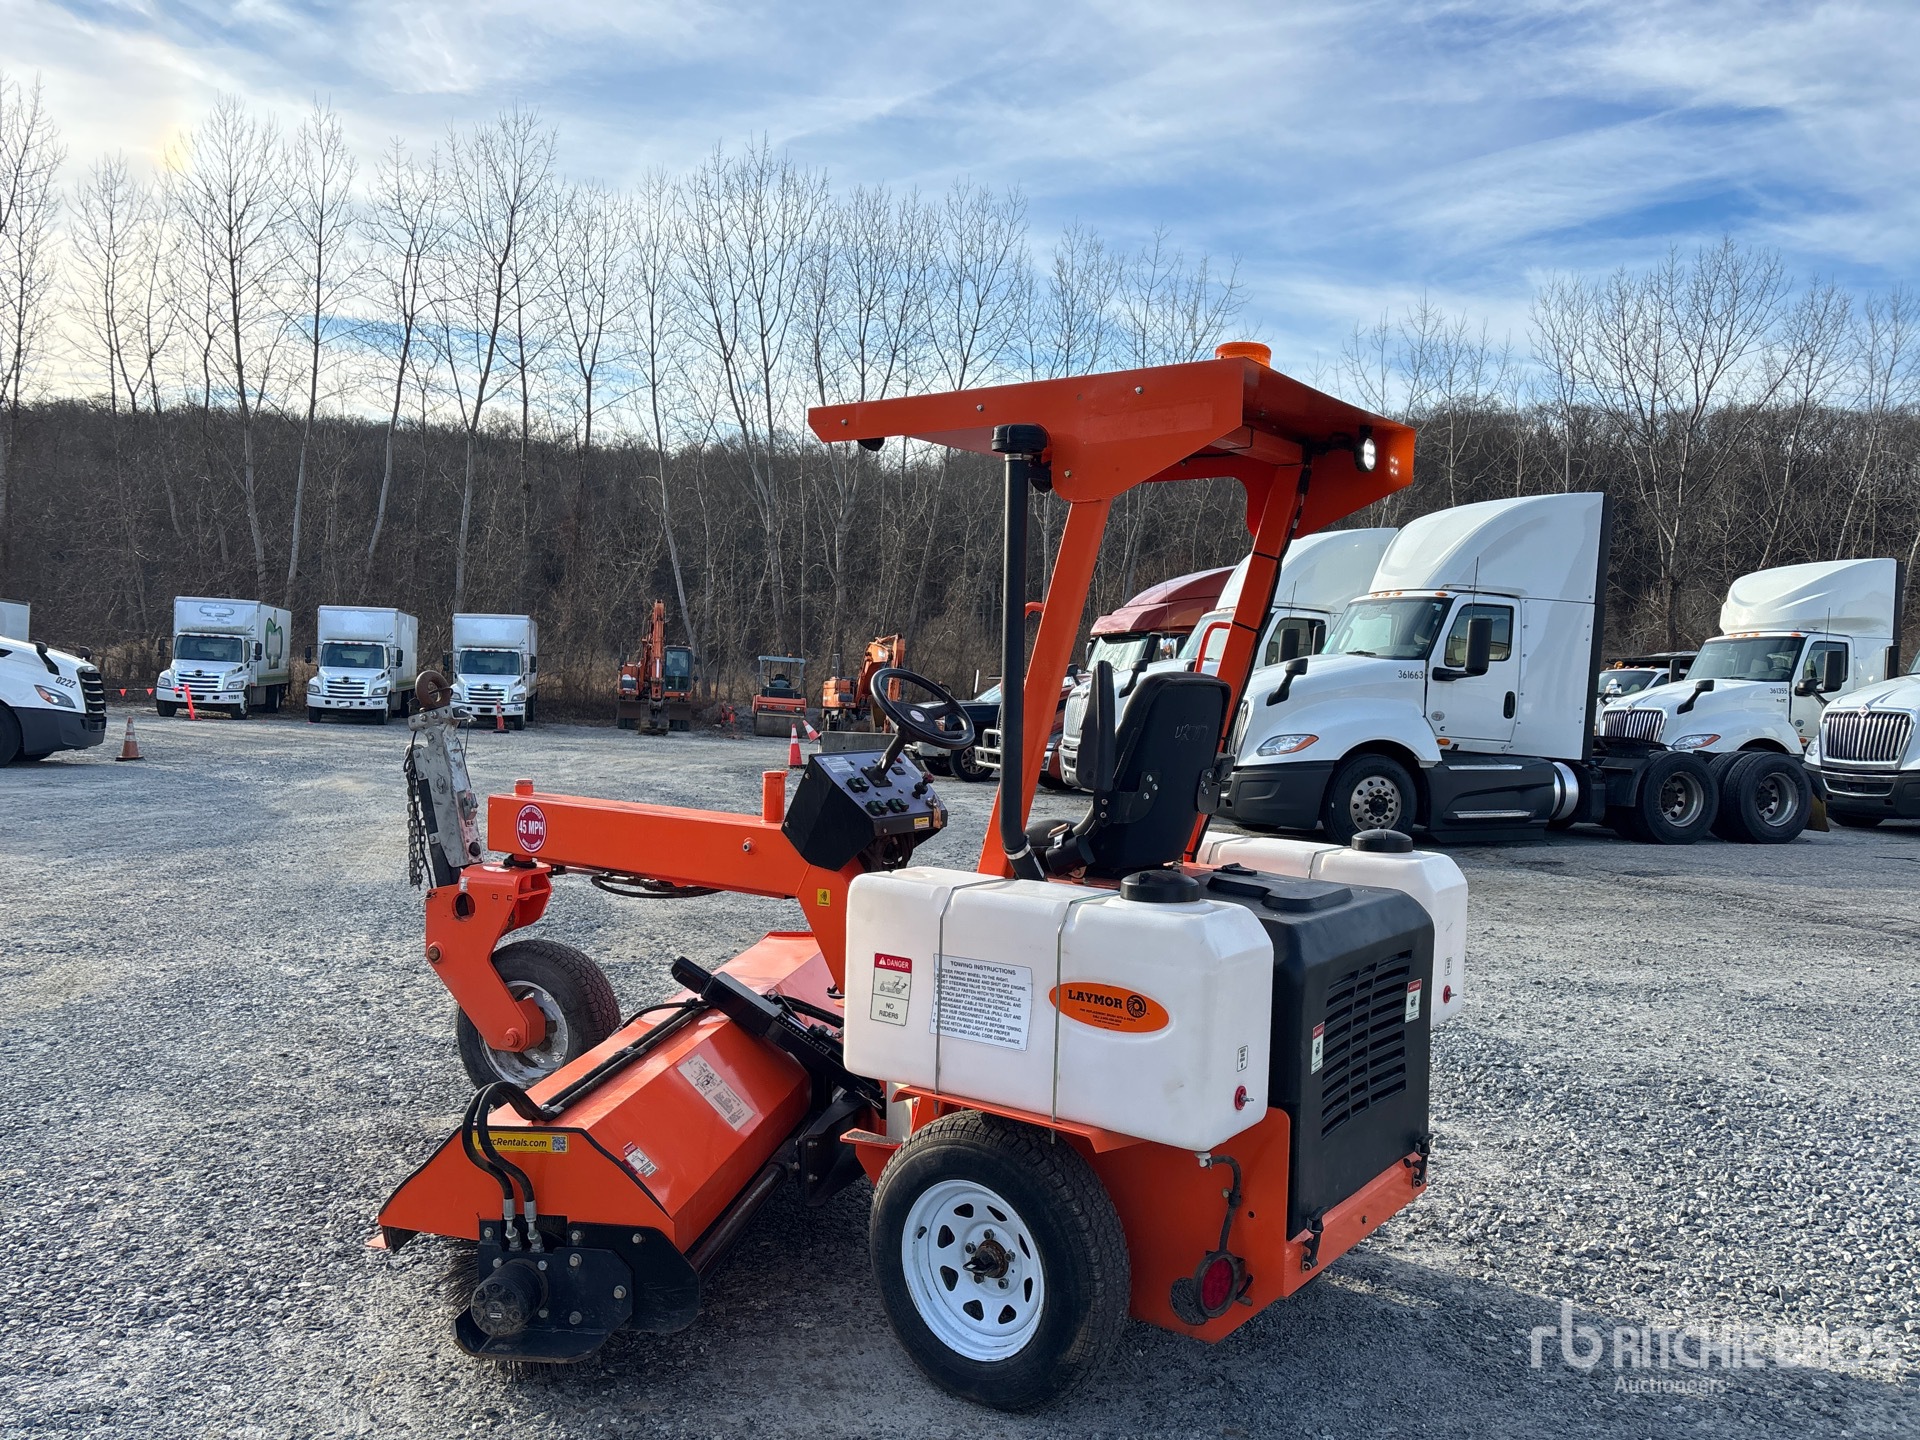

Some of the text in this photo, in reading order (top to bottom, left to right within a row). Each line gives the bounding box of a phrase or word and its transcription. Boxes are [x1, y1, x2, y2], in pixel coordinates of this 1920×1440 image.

[1398, 670, 1424, 680] 361663
[56, 676, 76, 688] 0222
[519, 820, 544, 835] 45 MPH
[886, 958, 909, 969] DANGER
[974, 964, 1016, 975] INSTRUCTIONS
[1068, 989, 1123, 1009] LAYMOR
[879, 1010, 899, 1020] RIDERS
[478, 1137, 547, 1148] cRentals.com
